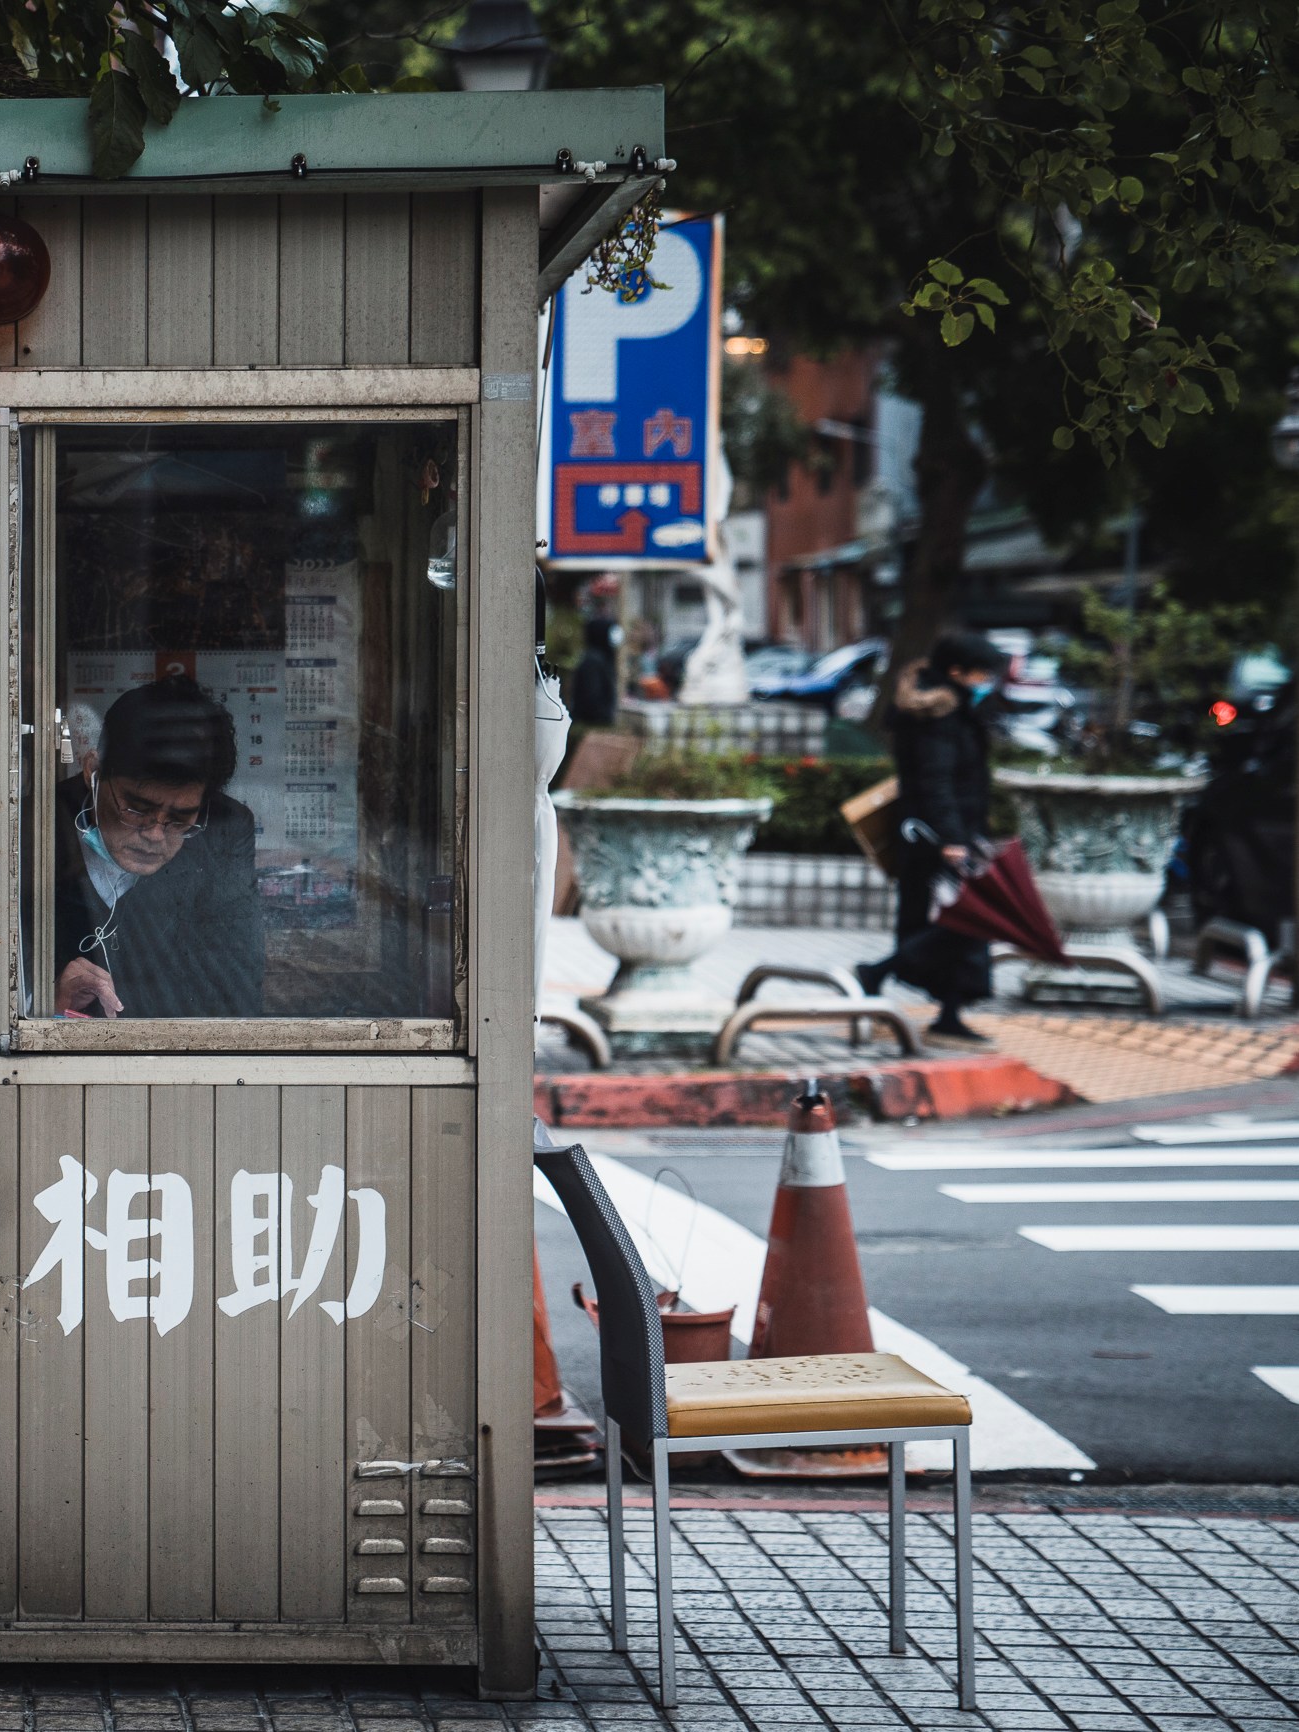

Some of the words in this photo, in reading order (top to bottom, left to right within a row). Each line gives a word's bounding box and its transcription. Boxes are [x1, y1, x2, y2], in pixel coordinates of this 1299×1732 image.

[562, 228, 701, 403] P
[293, 558, 337, 573] 2022
[250, 714, 261, 724] 11
[250, 735, 263, 745] 18
[249, 756, 263, 766] 25
